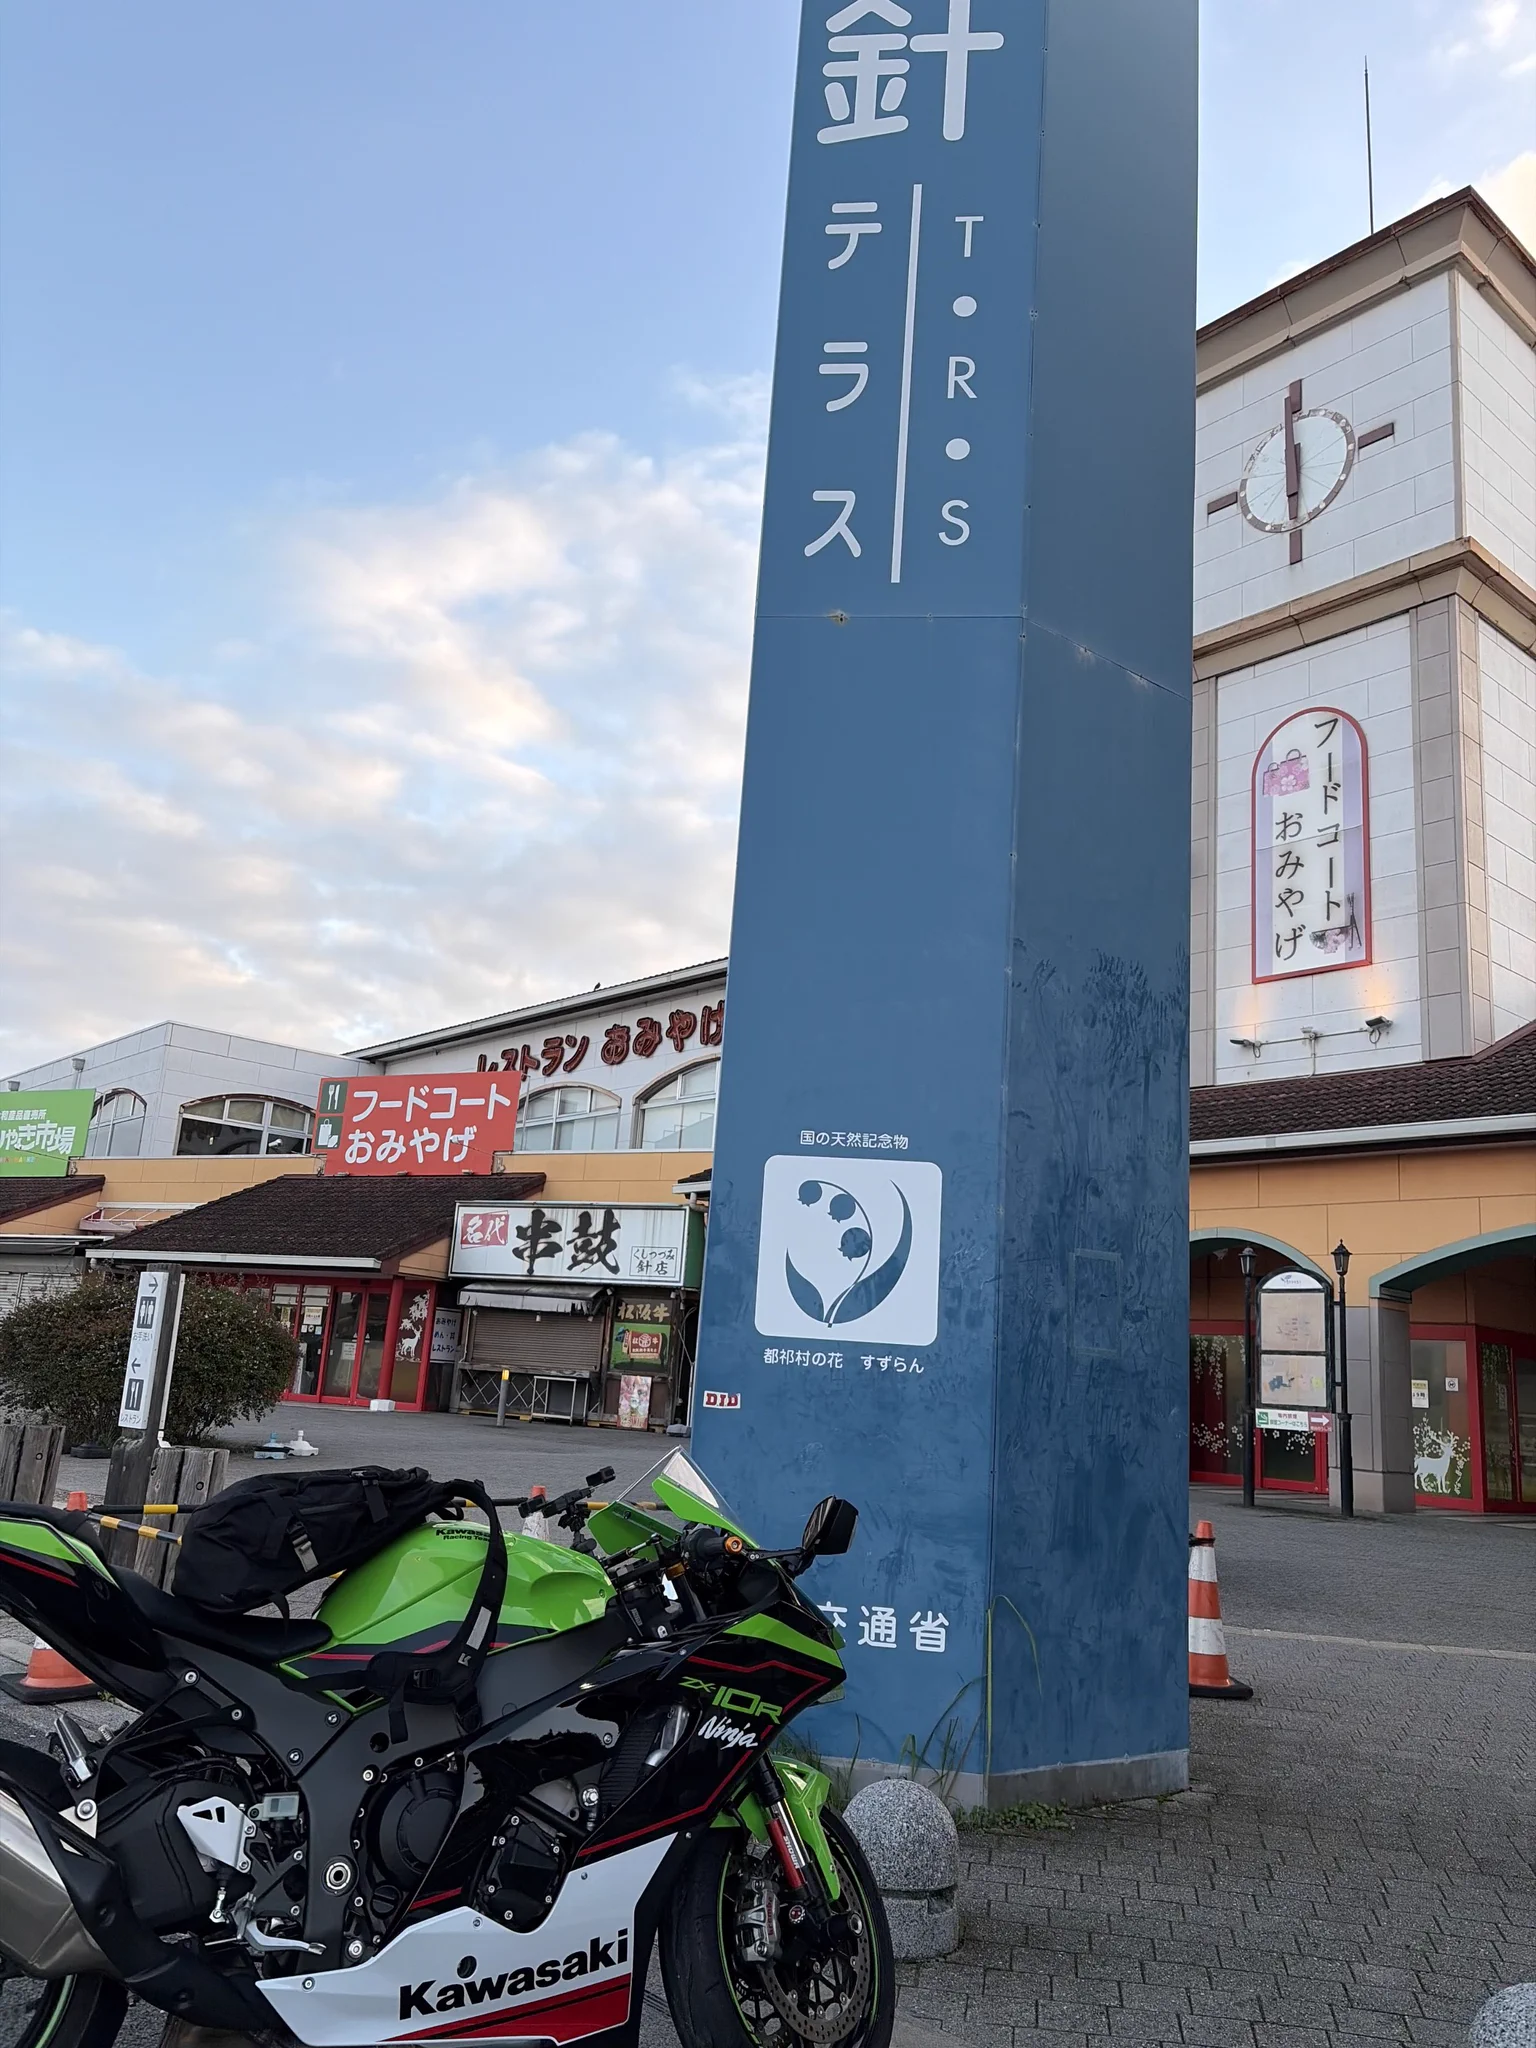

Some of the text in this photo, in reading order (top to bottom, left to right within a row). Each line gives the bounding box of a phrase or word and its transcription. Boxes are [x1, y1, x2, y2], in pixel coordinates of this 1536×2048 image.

[817, 0, 1005, 145] 針
[804, 201, 882, 559] テラス
[1314, 717, 1342, 922] フードコート
[1274, 811, 1307, 961] おみやげ
[477, 1034, 590, 1081] レストラン
[352, 1082, 511, 1123] フードコート
[344, 1125, 478, 1164] おみやげ
[800, 1130, 909, 1150] 国の天然記念物
[462, 1213, 507, 1245] 名代
[512, 1208, 622, 1276] 串鼓
[633, 1248, 675, 1261] くしつづみ
[635, 1260, 669, 1276] 針店
[617, 1301, 671, 1323] 松阪牛
[432, 1344, 455, 1353] レストラン
[763, 1348, 925, 1374] 都祁村の花 すずらん
[120, 1413, 141, 1424] レストラン
[678, 1676, 783, 1725] ZX-10R
[697, 1715, 759, 1751] Ninja
[782, 1834, 801, 1869] SHOWA
[400, 1927, 628, 2021] Kawasaki
